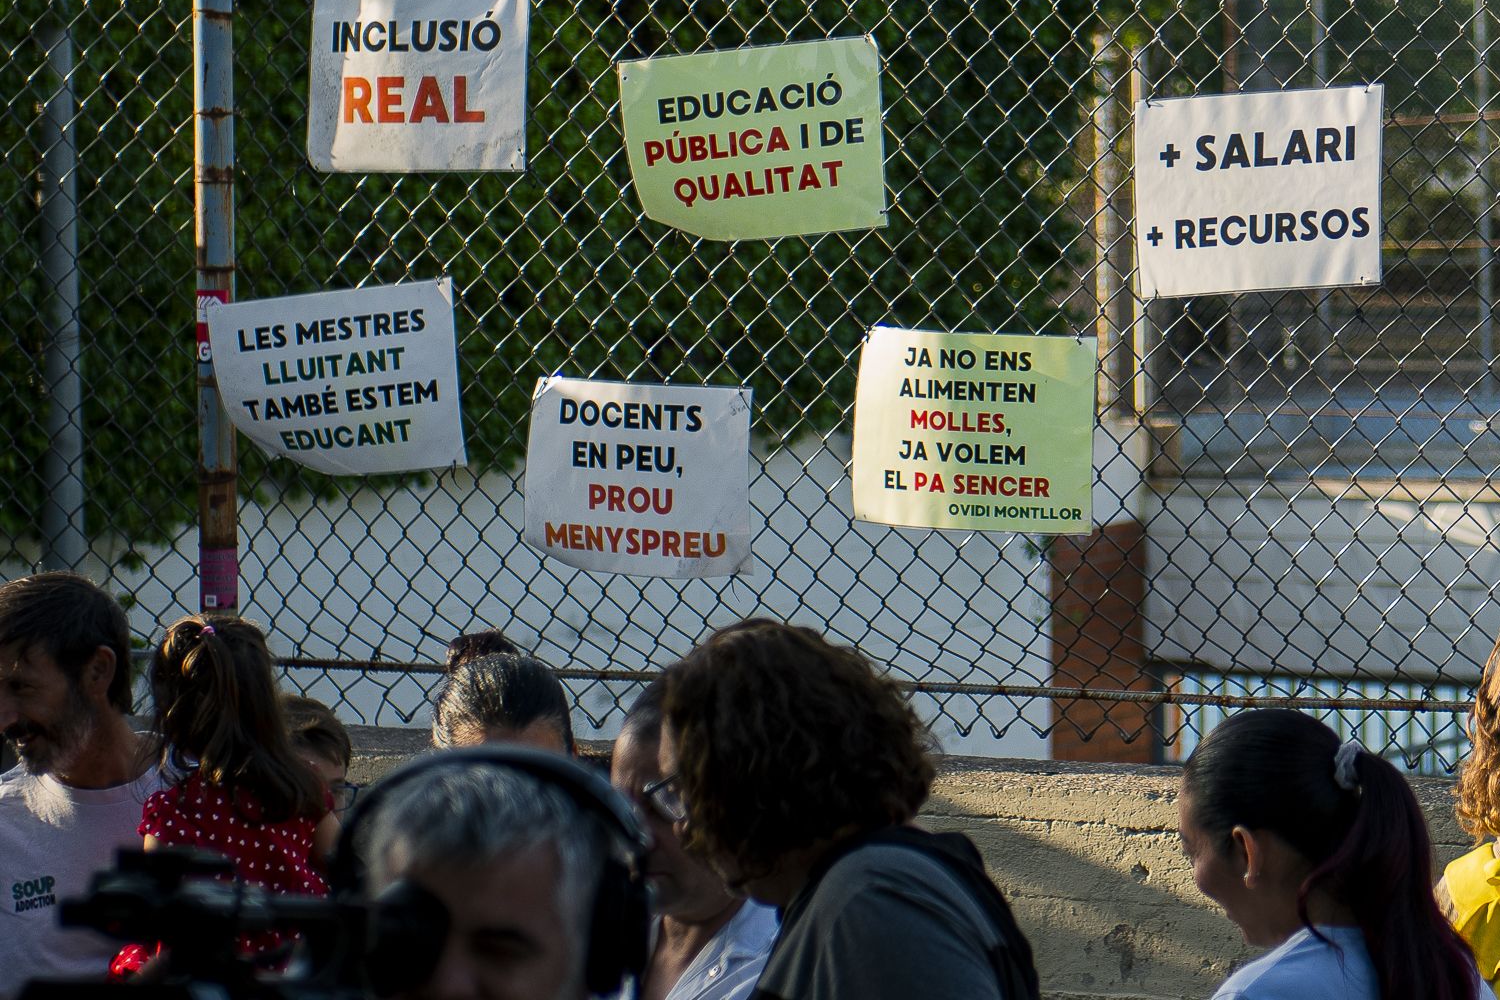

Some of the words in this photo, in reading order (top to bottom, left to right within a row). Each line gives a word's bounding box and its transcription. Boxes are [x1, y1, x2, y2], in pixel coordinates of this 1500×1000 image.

[331, 10, 502, 53] INCLUSIÓ
[343, 75, 485, 124] REAL
[657, 73, 843, 124] EDUCACIÓ
[643, 126, 790, 167] PÚBLICA
[800, 123, 809, 149] I
[819, 117, 864, 147] DE
[1159, 143, 1181, 168] +
[1195, 125, 1356, 172] SALARI
[673, 160, 843, 208] QUALITAT
[1146, 226, 1163, 246] +
[1175, 207, 1370, 250] RECURSOS
[237, 324, 287, 353] LES
[295, 309, 425, 345] MESTRES
[262, 347, 405, 385] LLUITANT
[904, 347, 932, 368] JA
[939, 349, 977, 370] NO
[984, 351, 1032, 372] ENS
[242, 385, 339, 421] TAMBÉ
[345, 379, 439, 412] ESTEM
[899, 378, 1036, 404] ALIMENTEN
[559, 398, 702, 432] DOCENTS
[910, 409, 1012, 437] MOLLES,
[279, 418, 411, 451] EDUCANT
[572, 441, 607, 469] EN
[616, 444, 683, 478] PEU,
[898, 440, 928, 461] JA
[936, 442, 1026, 466] VOLEM
[588, 483, 673, 515] PROU
[884, 469, 907, 490] EL
[914, 472, 945, 493] PA
[953, 474, 1050, 498] SENCER
[948, 503, 990, 517] OVIDI
[994, 505, 1082, 521] MONTLLOR
[544, 522, 726, 558] MENYSPREU
[12, 875, 55, 900] SOUP
[15, 894, 56, 913] ADDICTION
